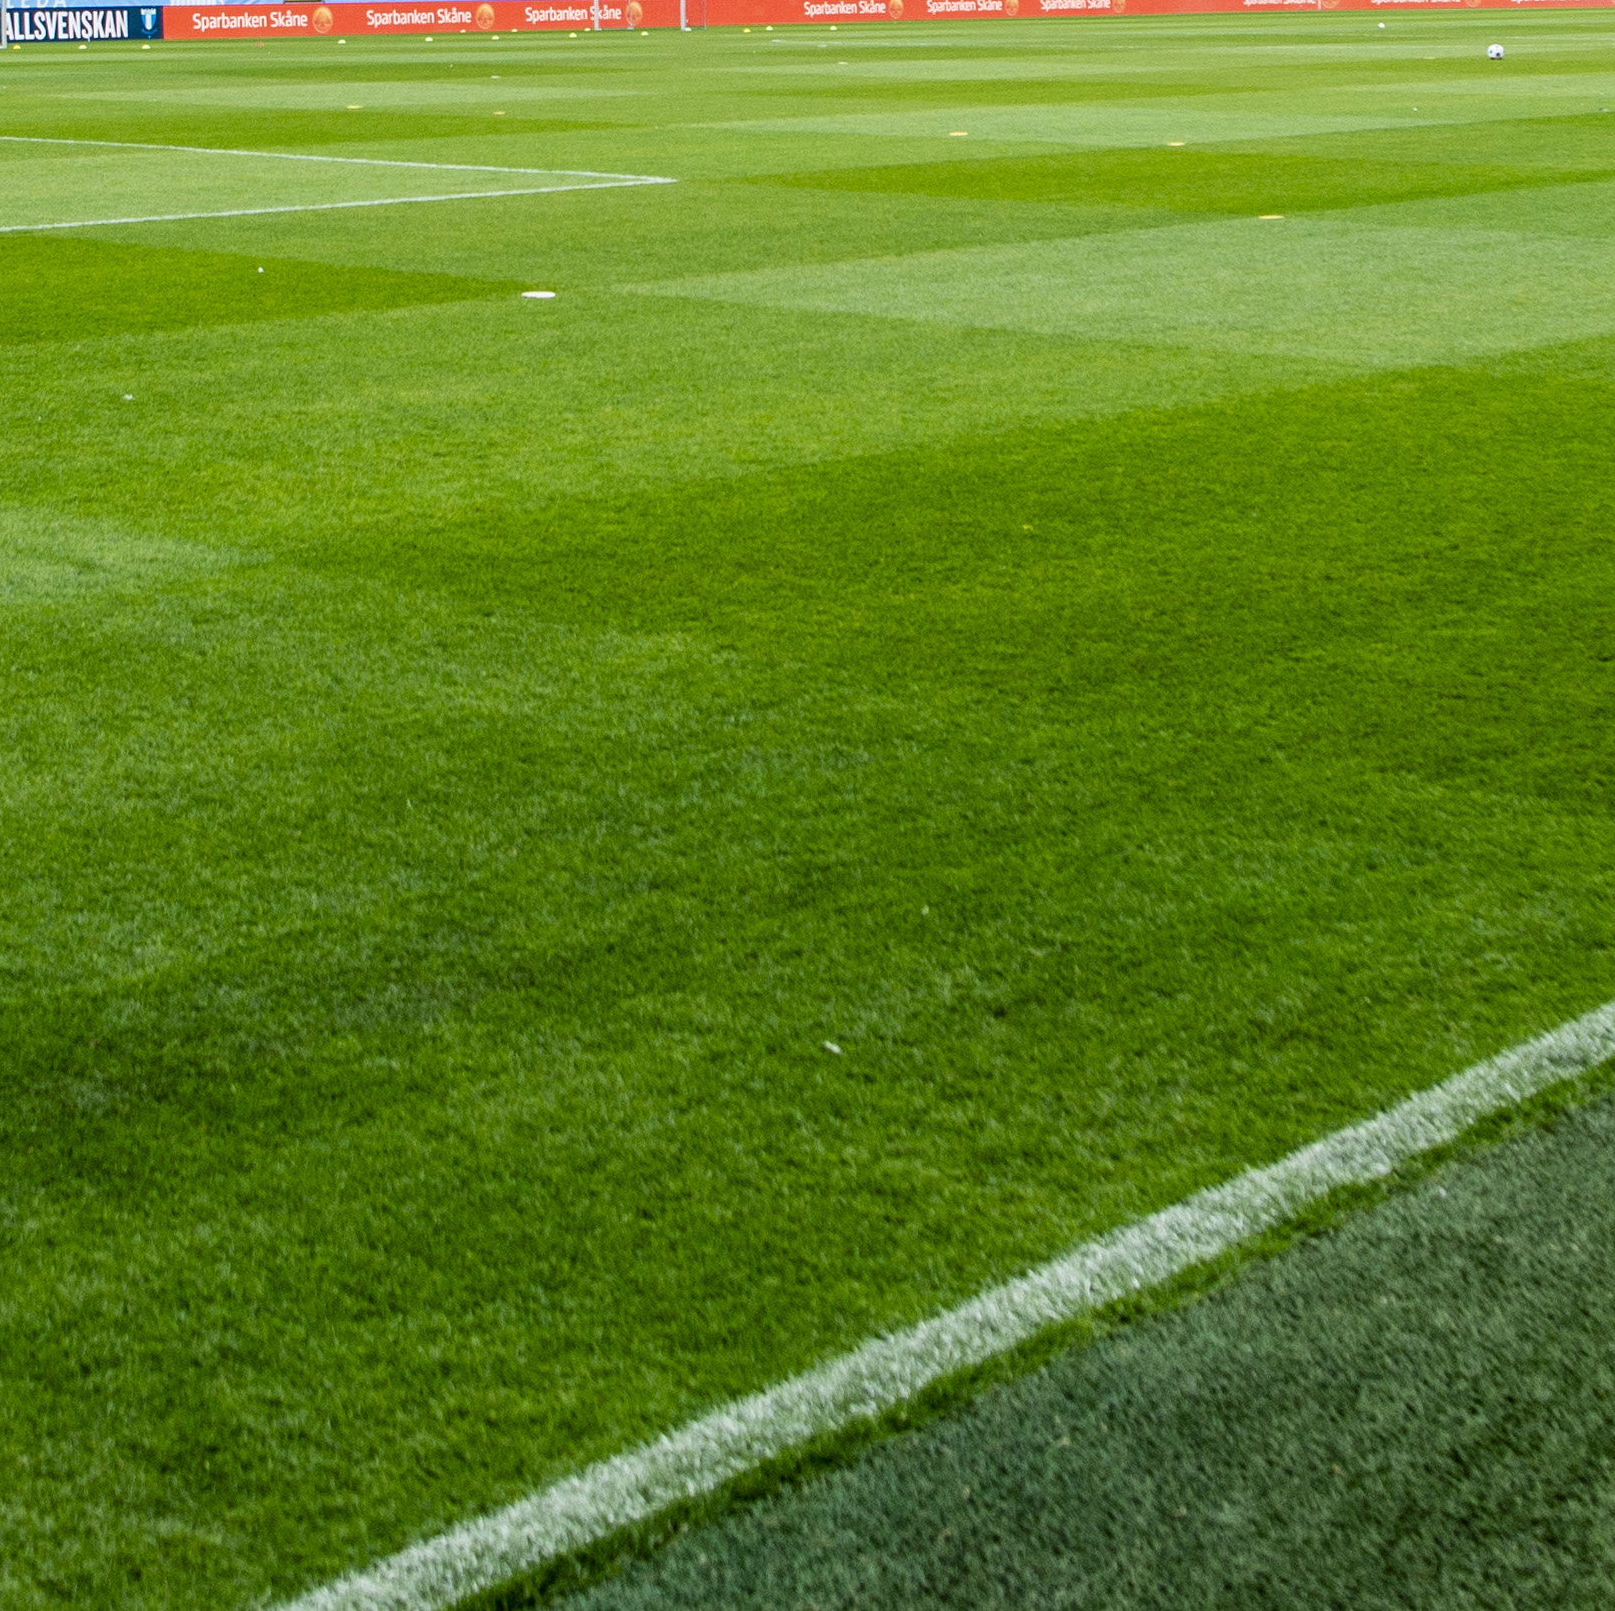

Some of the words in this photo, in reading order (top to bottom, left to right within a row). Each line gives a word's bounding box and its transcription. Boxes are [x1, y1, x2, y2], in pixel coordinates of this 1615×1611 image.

[525, 6, 587, 24] Sparbanken
[804, 1, 857, 17] Sparbanken
[859, 0, 886, 14] Skåne
[926, 0, 976, 14] Sparbanken
[5, 10, 128, 41] ALLSVENSKAN
[192, 12, 267, 32] Sparbanken
[270, 10, 308, 27] Skåne
[366, 9, 435, 28] Sparbanken
[437, 7, 472, 24] Skåne
